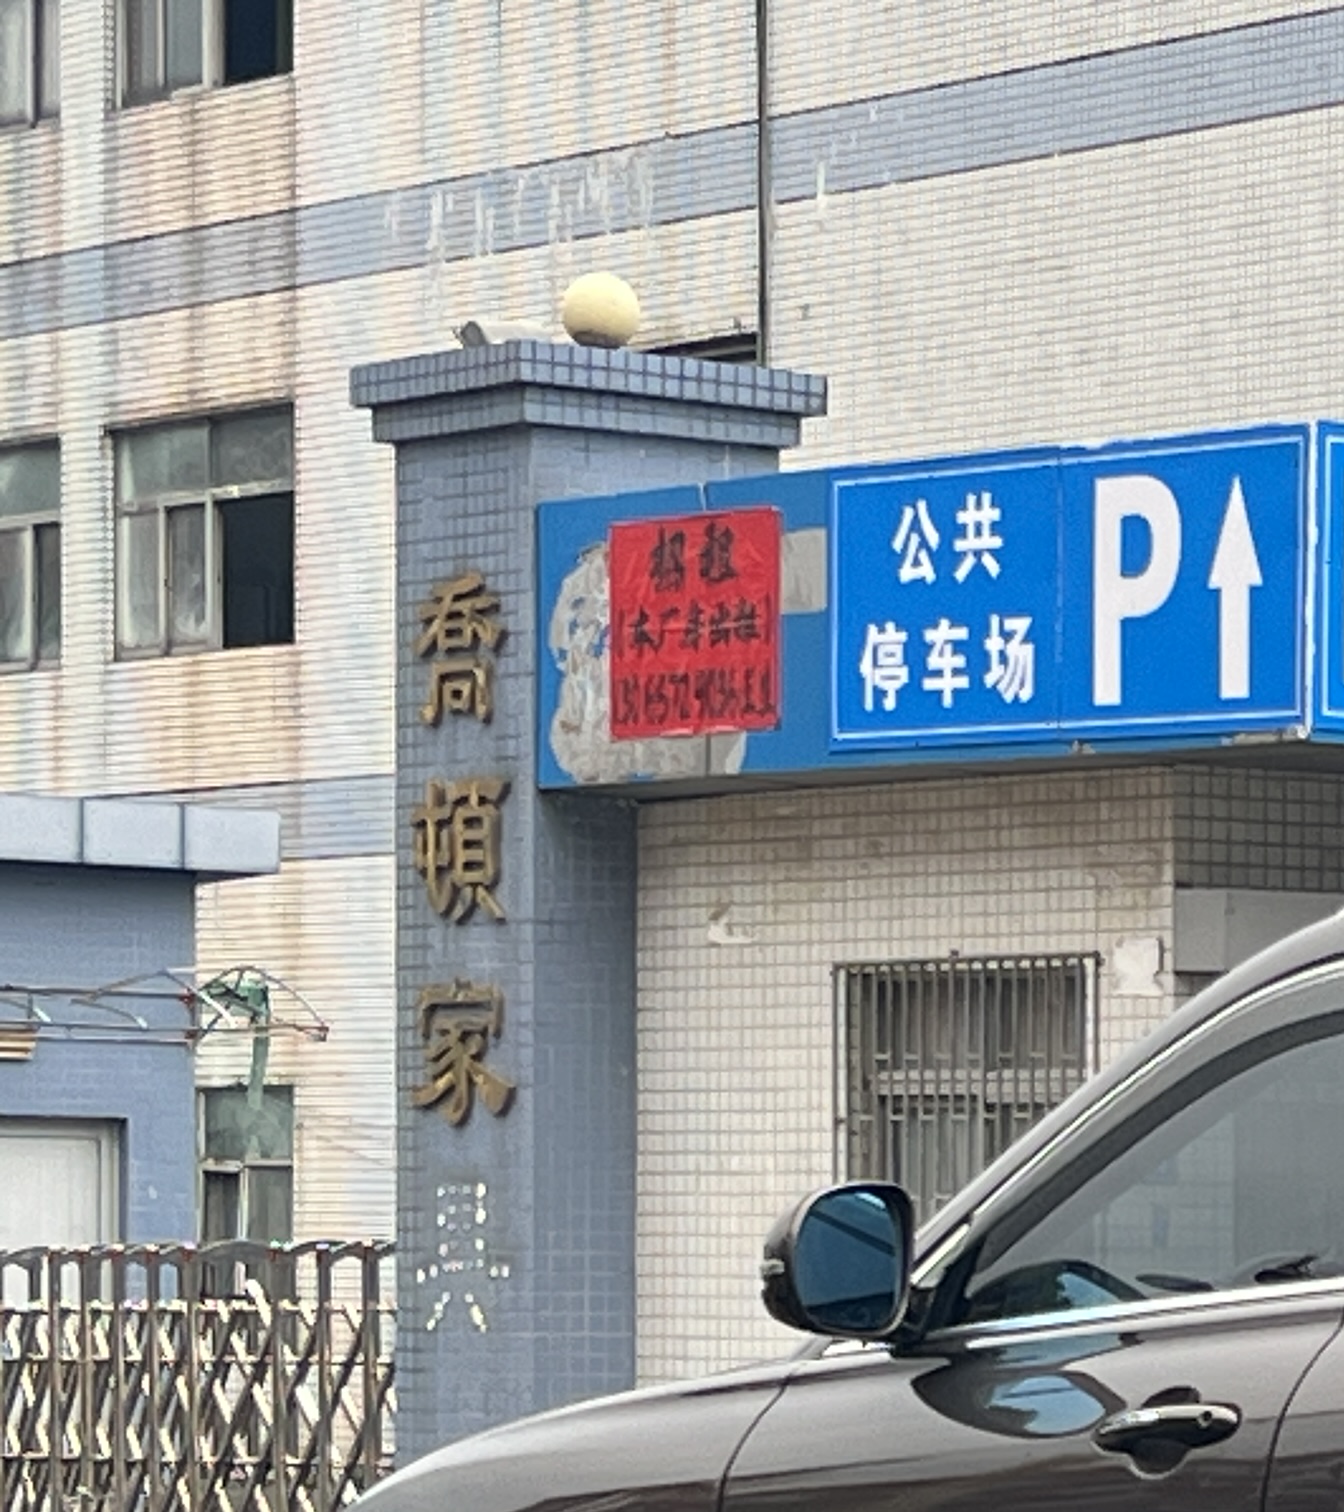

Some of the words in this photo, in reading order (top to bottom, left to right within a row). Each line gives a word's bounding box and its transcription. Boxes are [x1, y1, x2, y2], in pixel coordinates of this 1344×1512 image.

[892, 491, 1003, 584] 公共
[1093, 474, 1182, 706] P
[859, 613, 1035, 711] 停车场
